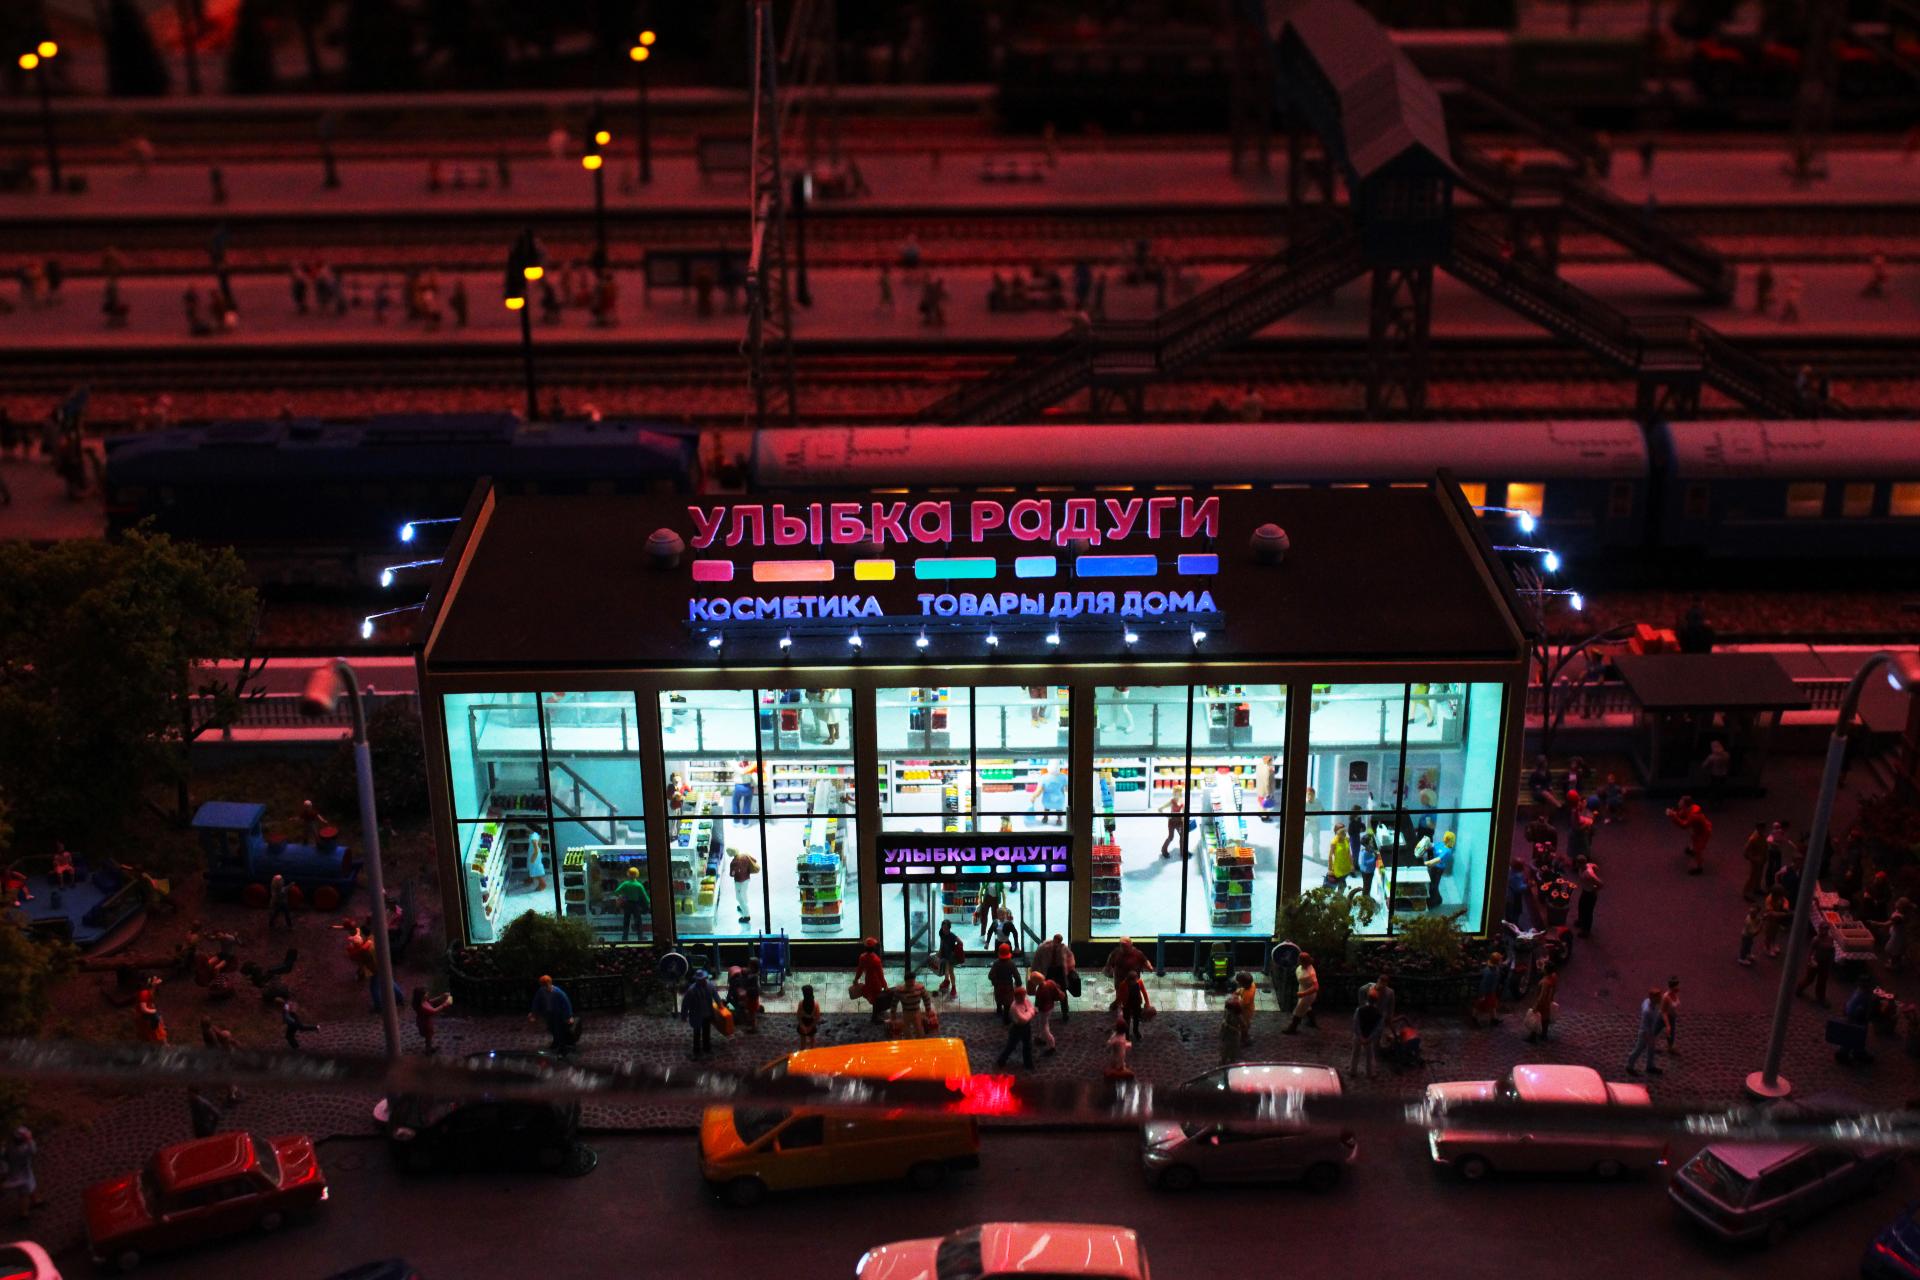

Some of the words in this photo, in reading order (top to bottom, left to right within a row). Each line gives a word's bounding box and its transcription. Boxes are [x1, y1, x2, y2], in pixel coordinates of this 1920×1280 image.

[688, 594, 884, 622] КОСМЕТИКА
[917, 592, 1045, 618] ТОВАРЫ
[1049, 591, 1116, 618] ДЛЯ
[1121, 590, 1217, 618] ДОМА
